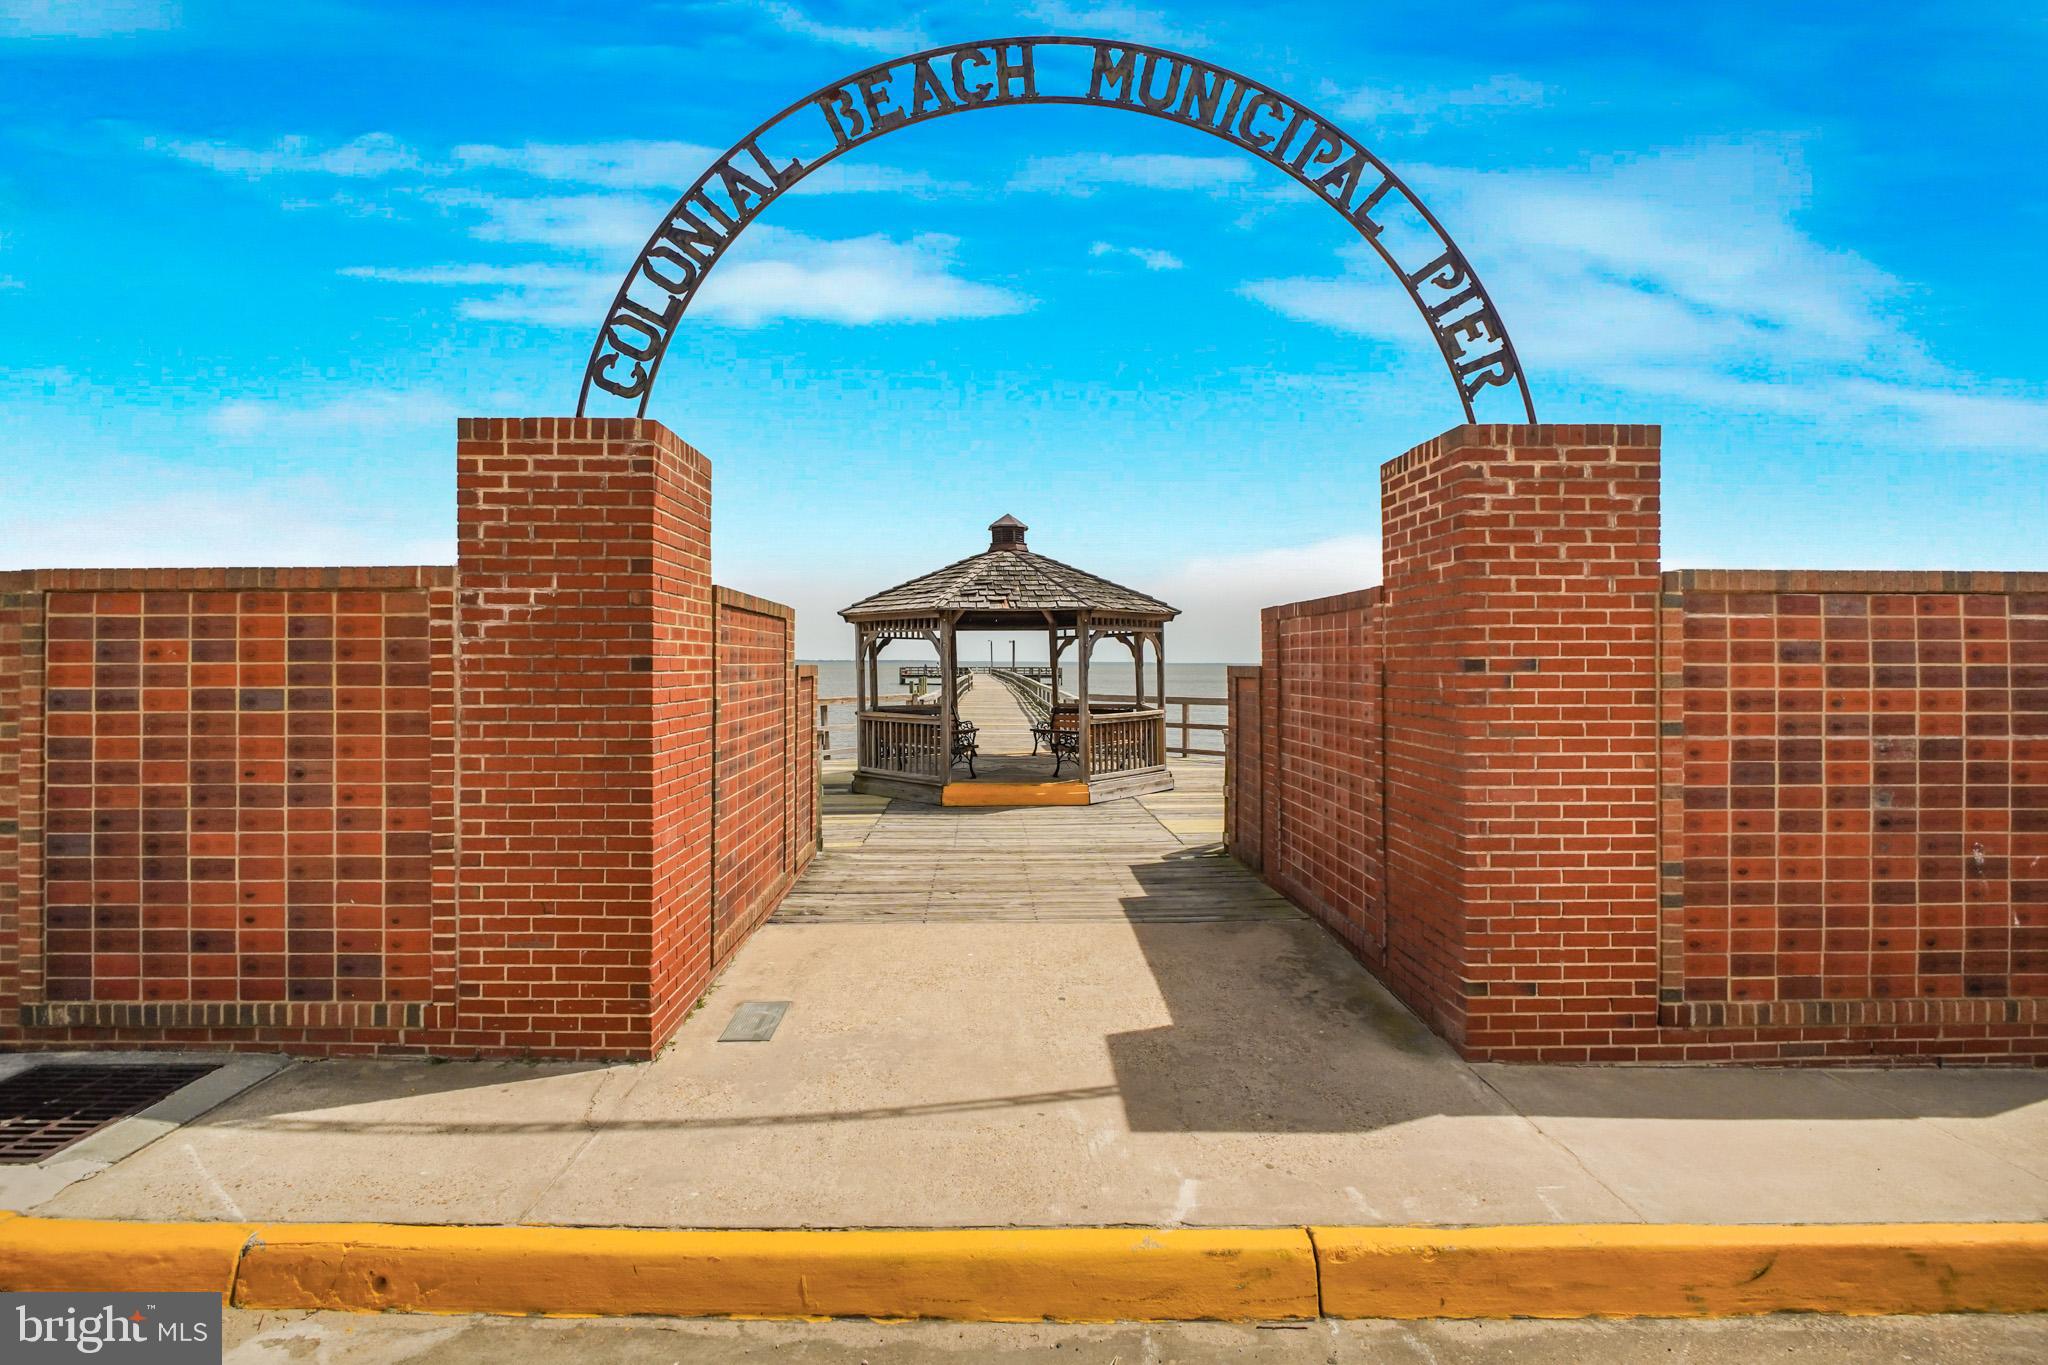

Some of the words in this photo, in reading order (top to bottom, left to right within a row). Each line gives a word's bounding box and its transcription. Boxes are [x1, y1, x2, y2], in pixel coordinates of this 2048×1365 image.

[592, 136, 804, 399] COLONIAL
[814, 43, 1040, 149] BEACH
[1085, 45, 1399, 237] MUNICIPAL
[1407, 246, 1517, 402] PIER
